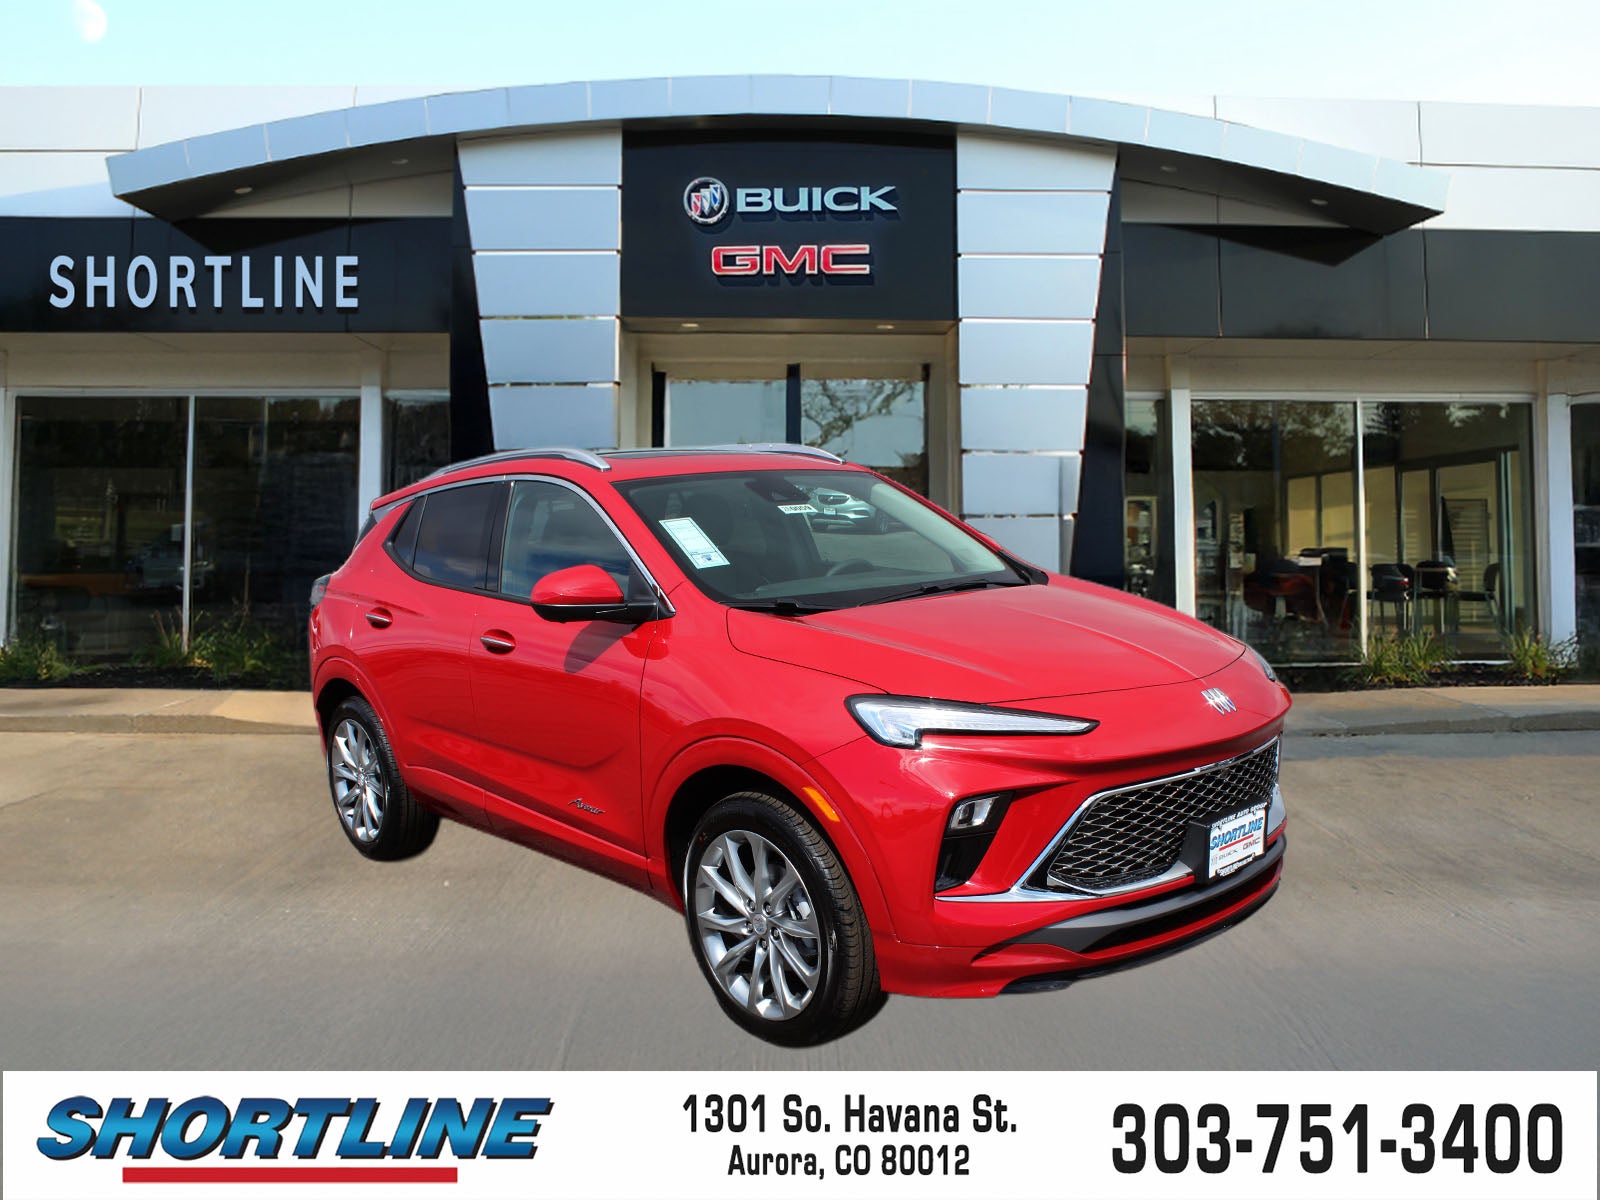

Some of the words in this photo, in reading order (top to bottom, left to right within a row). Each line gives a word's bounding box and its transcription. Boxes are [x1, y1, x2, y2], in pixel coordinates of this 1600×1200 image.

[736, 185, 898, 213] BUICK
[711, 244, 871, 276] GMC
[49, 255, 360, 309] SHORTLINE
[1210, 817, 1264, 850] SHORTLINE
[1242, 837, 1261, 851] GMC
